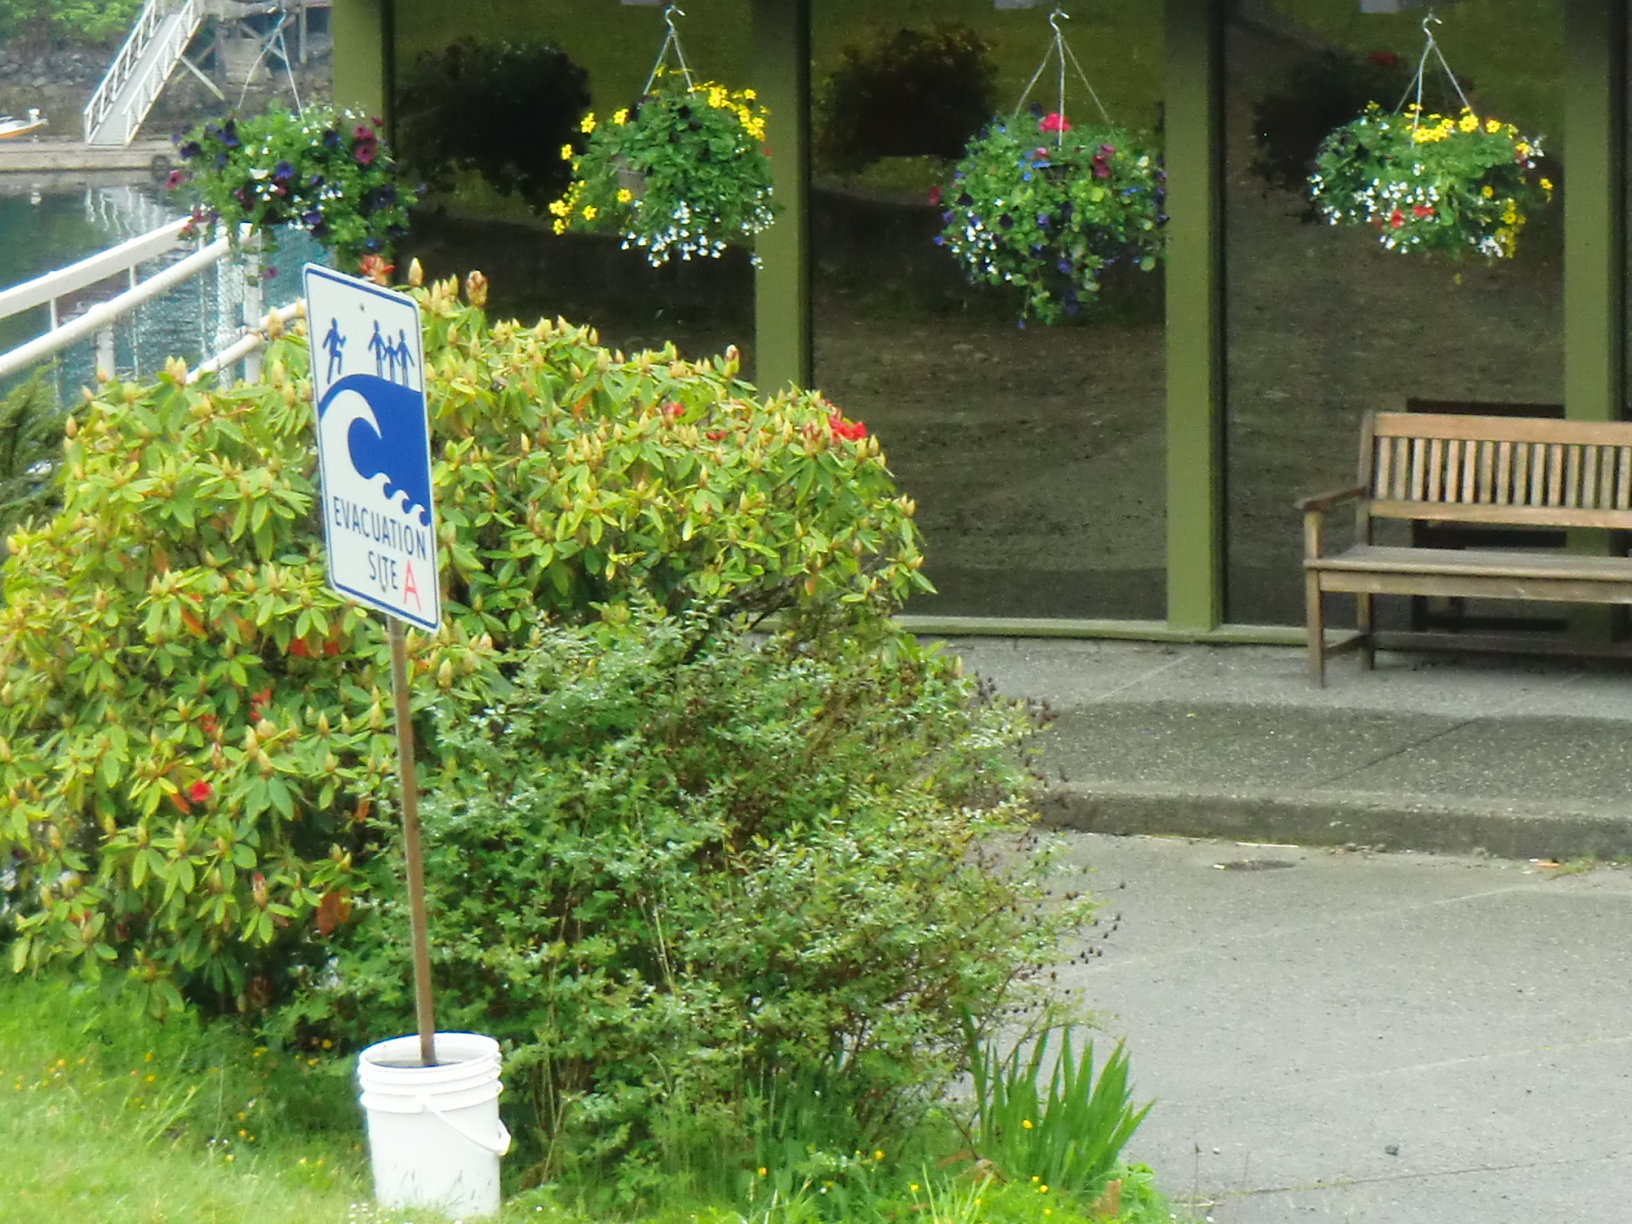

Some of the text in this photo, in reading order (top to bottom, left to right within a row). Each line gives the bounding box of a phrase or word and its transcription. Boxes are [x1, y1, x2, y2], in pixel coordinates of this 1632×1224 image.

[334, 496, 427, 560] EVACUATION
[368, 551, 421, 611] SITE A
